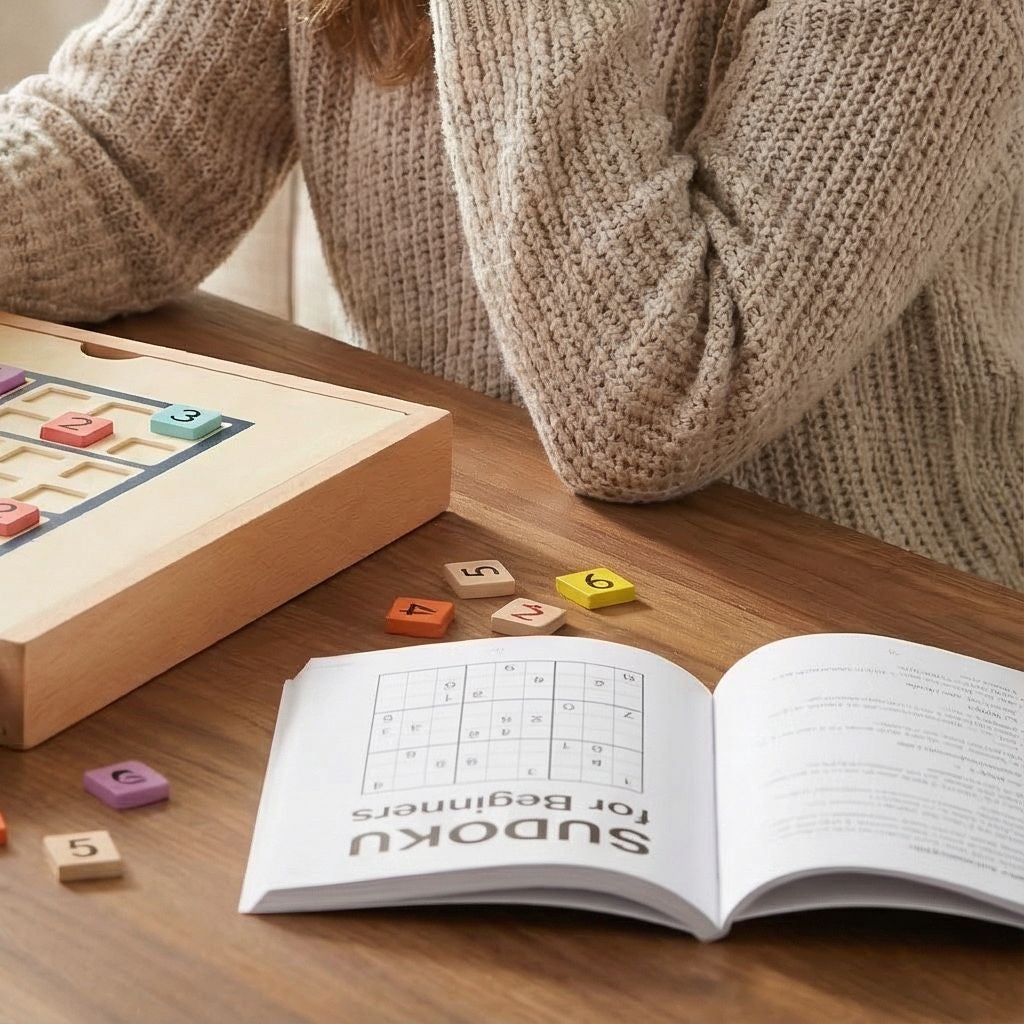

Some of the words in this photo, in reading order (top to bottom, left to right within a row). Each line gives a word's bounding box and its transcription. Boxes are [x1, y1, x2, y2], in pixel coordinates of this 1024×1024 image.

[58, 417, 93, 431] 2
[170, 409, 202, 423] 3
[352, 791, 572, 821] Beginners
[589, 799, 649, 825] for
[69, 838, 98, 858] 5
[349, 818, 650, 855] SUDOKU
